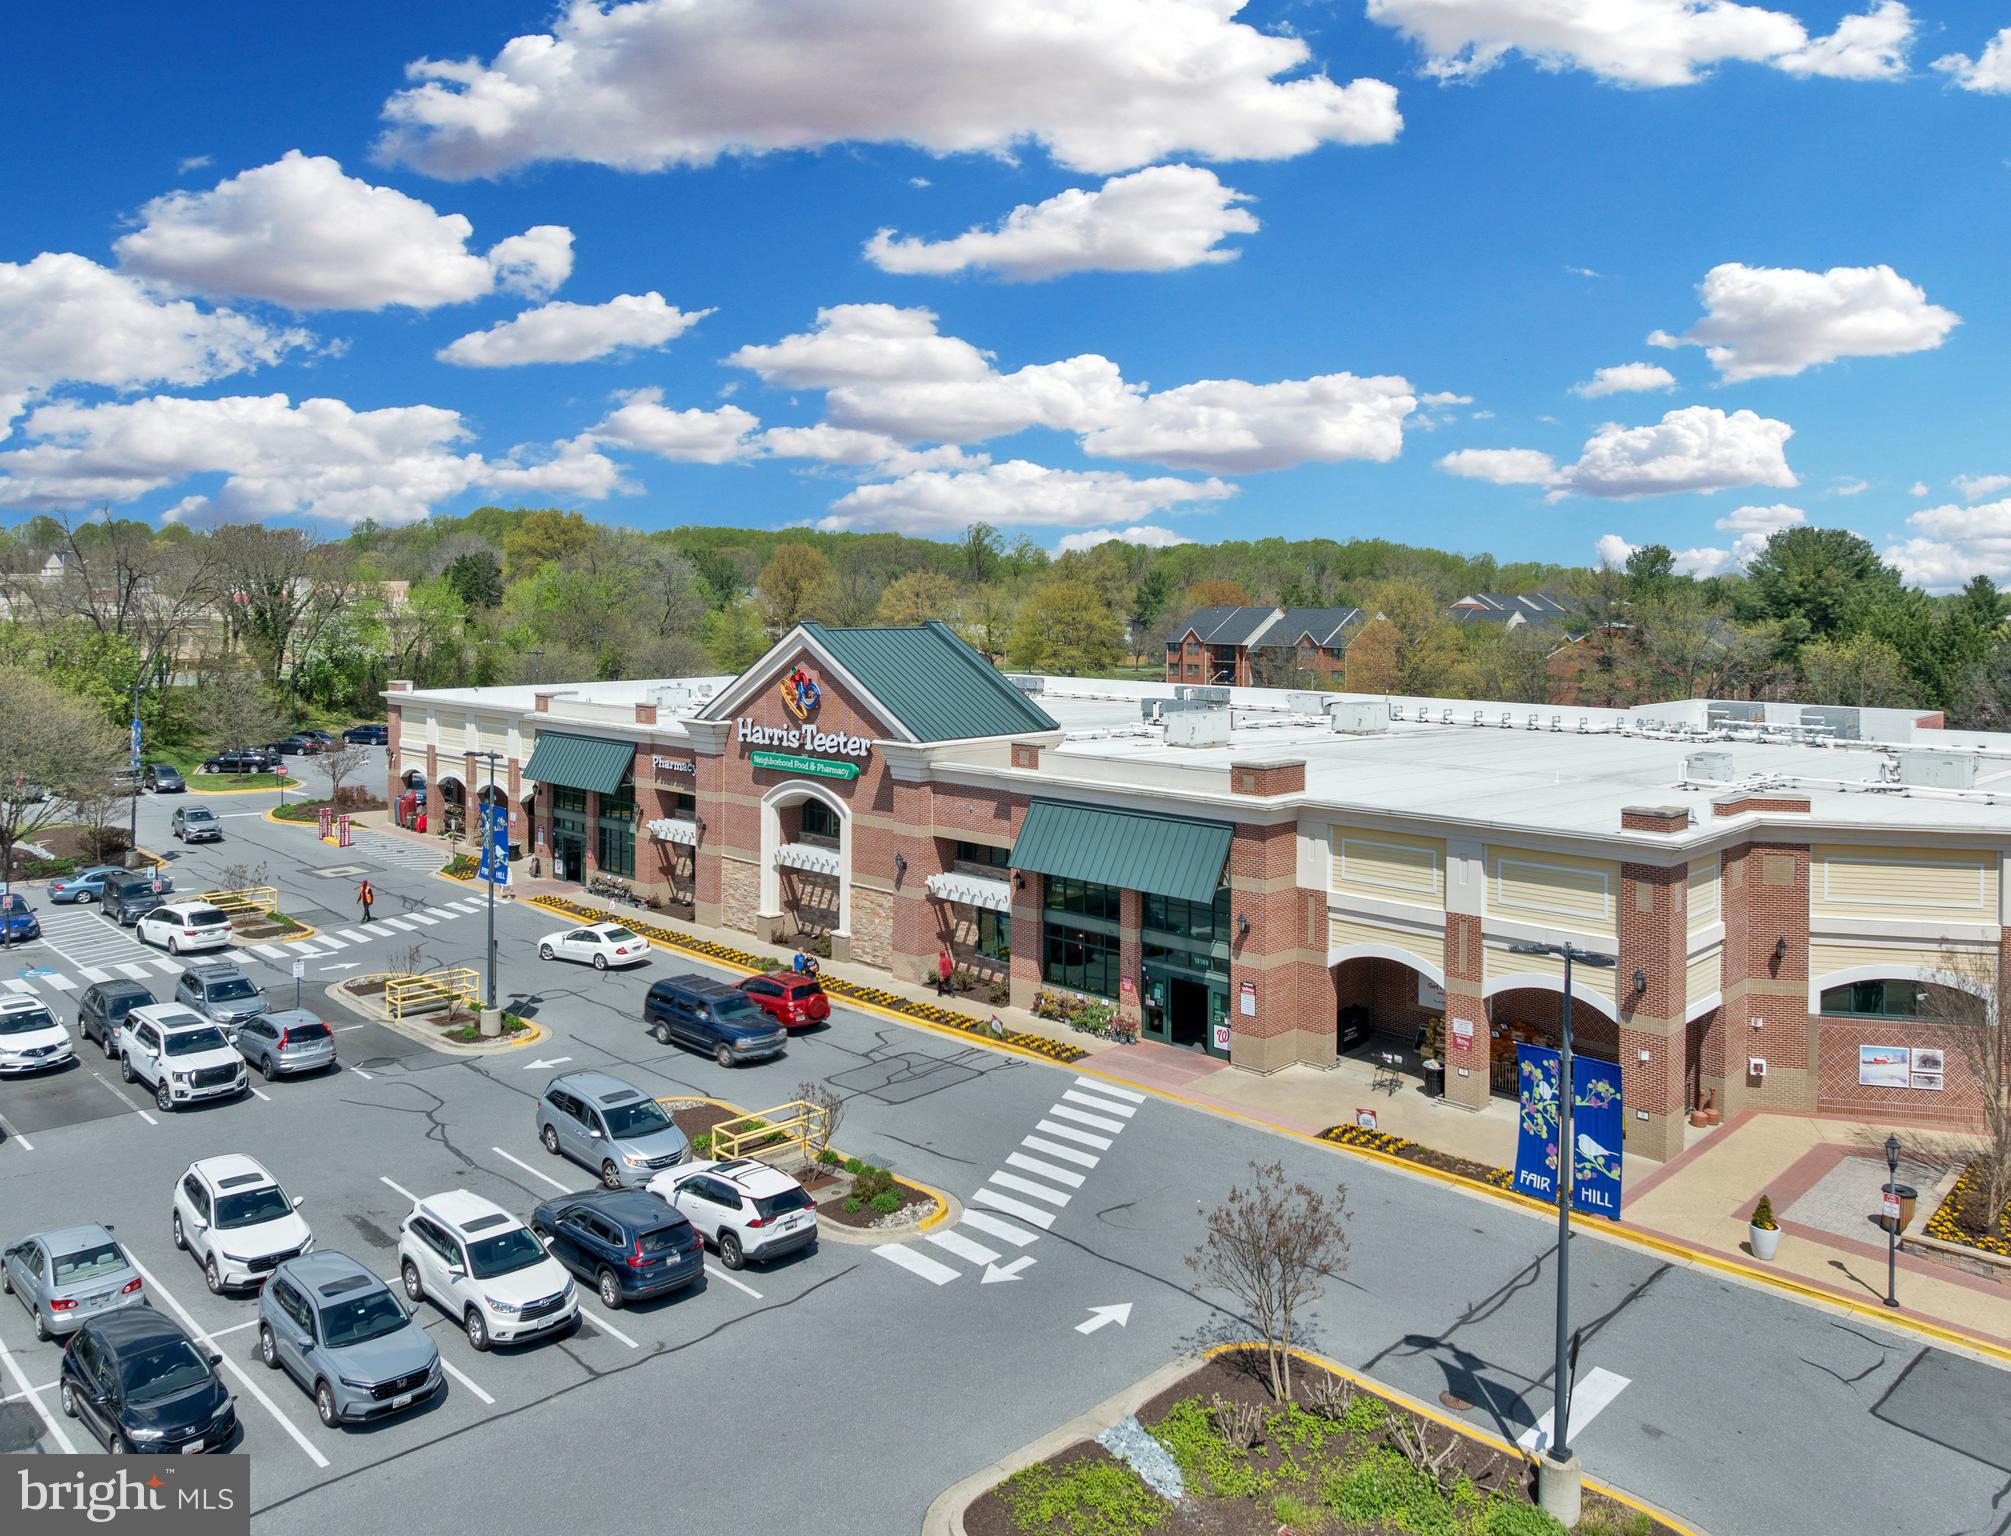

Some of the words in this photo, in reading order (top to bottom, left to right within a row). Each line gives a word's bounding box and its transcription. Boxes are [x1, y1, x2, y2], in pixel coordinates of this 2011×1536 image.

[737, 717, 799, 748] Harris
[801, 724, 870, 756] Teeter
[652, 755, 696, 776] Pharmacy
[754, 755, 793, 767] Neighborhood
[794, 761, 809, 770] Food
[810, 763, 816, 771] &
[817, 763, 849, 777] Pharmacy
[1520, 1169, 1551, 1192] FAIR
[1581, 1187, 1613, 1208] HILL
